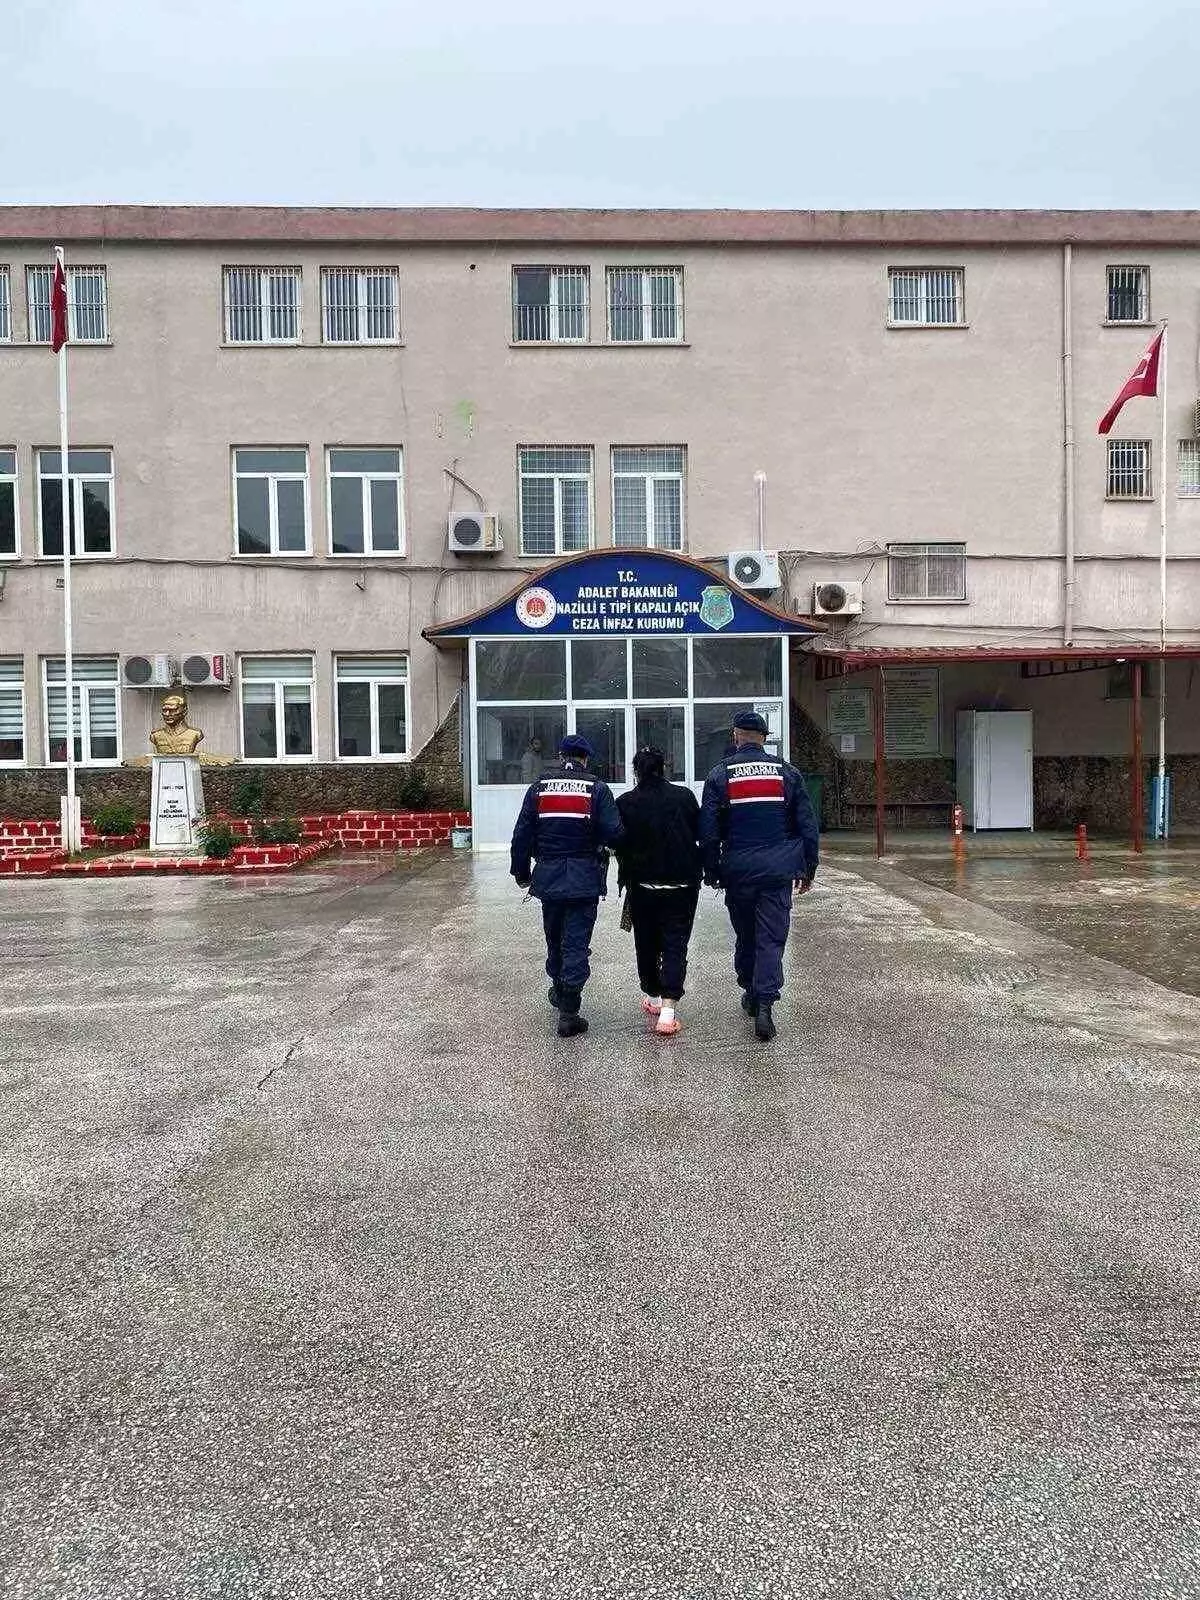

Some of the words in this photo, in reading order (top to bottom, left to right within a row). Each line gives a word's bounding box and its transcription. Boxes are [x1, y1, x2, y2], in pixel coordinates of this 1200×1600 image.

[617, 571, 638, 582] T.C.
[578, 586, 618, 598] ADALET
[621, 583, 678, 598] BAKANLIĞI
[557, 600, 597, 614] NAZİLLİ
[600, 602, 607, 614] E
[610, 599, 631, 614] TİPİ
[634, 602, 671, 614] KAPALI
[674, 602, 700, 616] AÇIK
[572, 618, 600, 630] CEZA
[603, 616, 634, 630] İNFAZ
[637, 617, 685, 629] KURUMU
[733, 764, 779, 778] JANDARMA
[543, 781, 588, 793] JANDARMA
